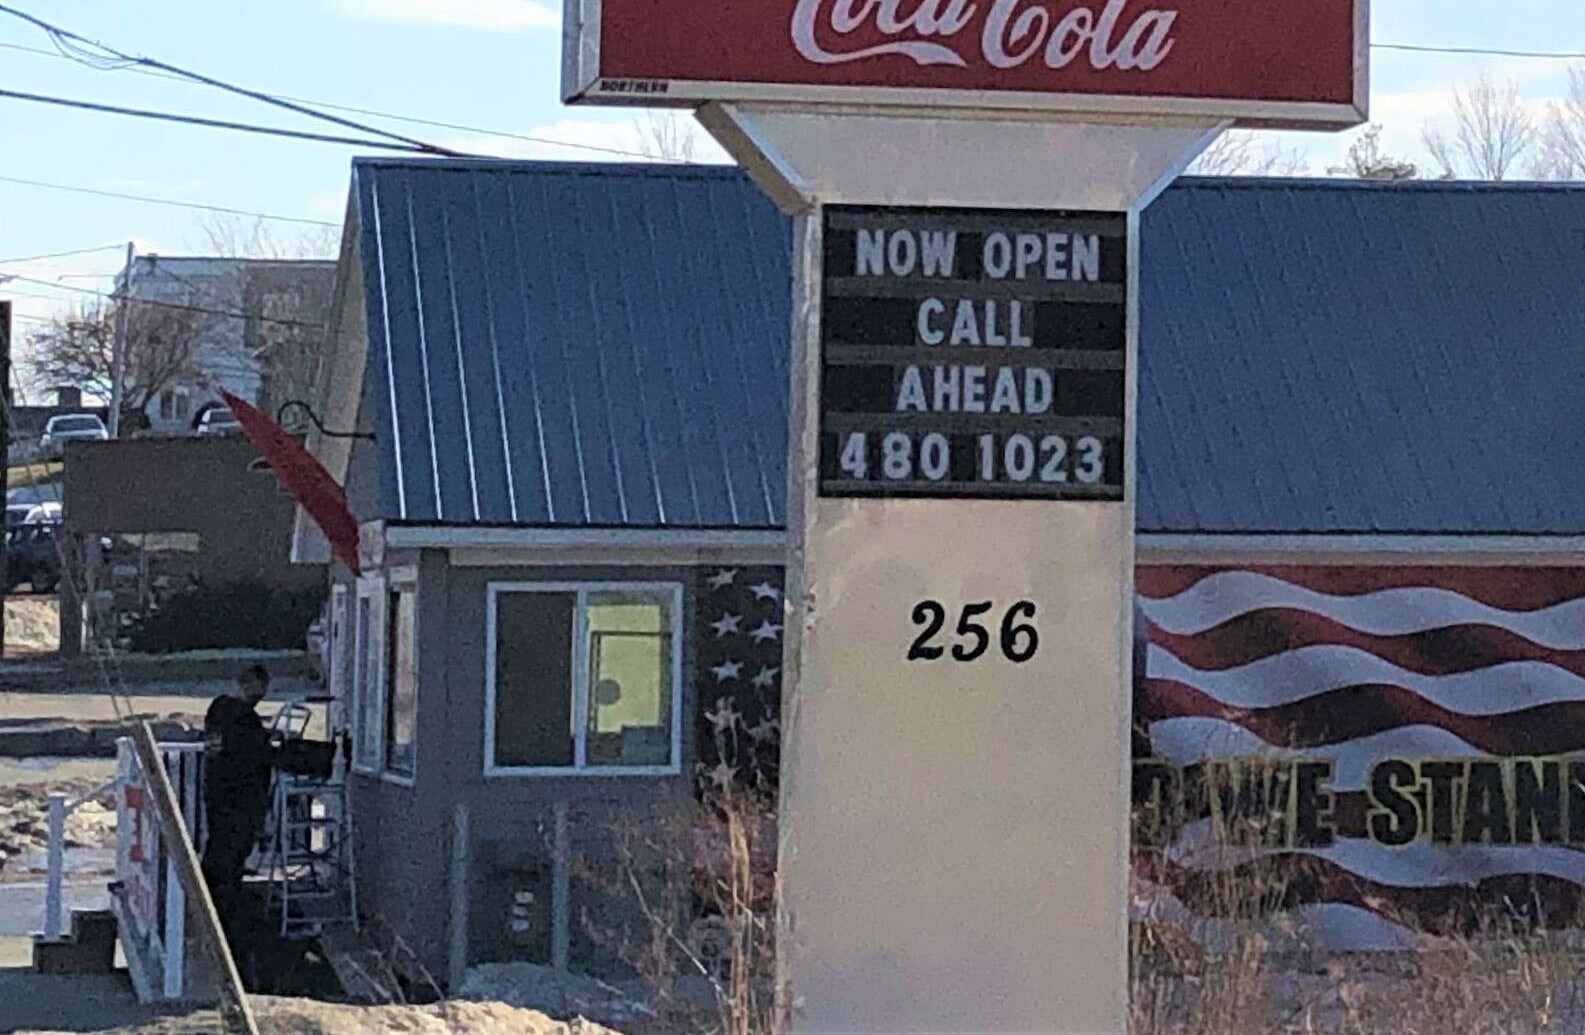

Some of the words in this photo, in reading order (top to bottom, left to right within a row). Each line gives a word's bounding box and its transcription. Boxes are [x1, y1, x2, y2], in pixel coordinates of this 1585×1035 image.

[856, 229, 956, 277] NOW
[983, 232, 1100, 281] OPEN
[917, 298, 1033, 347] CALL
[896, 365, 1054, 414] AHEAD
[840, 432, 950, 480] 480
[977, 433, 1104, 483] 1023
[907, 600, 1039, 663] 256
